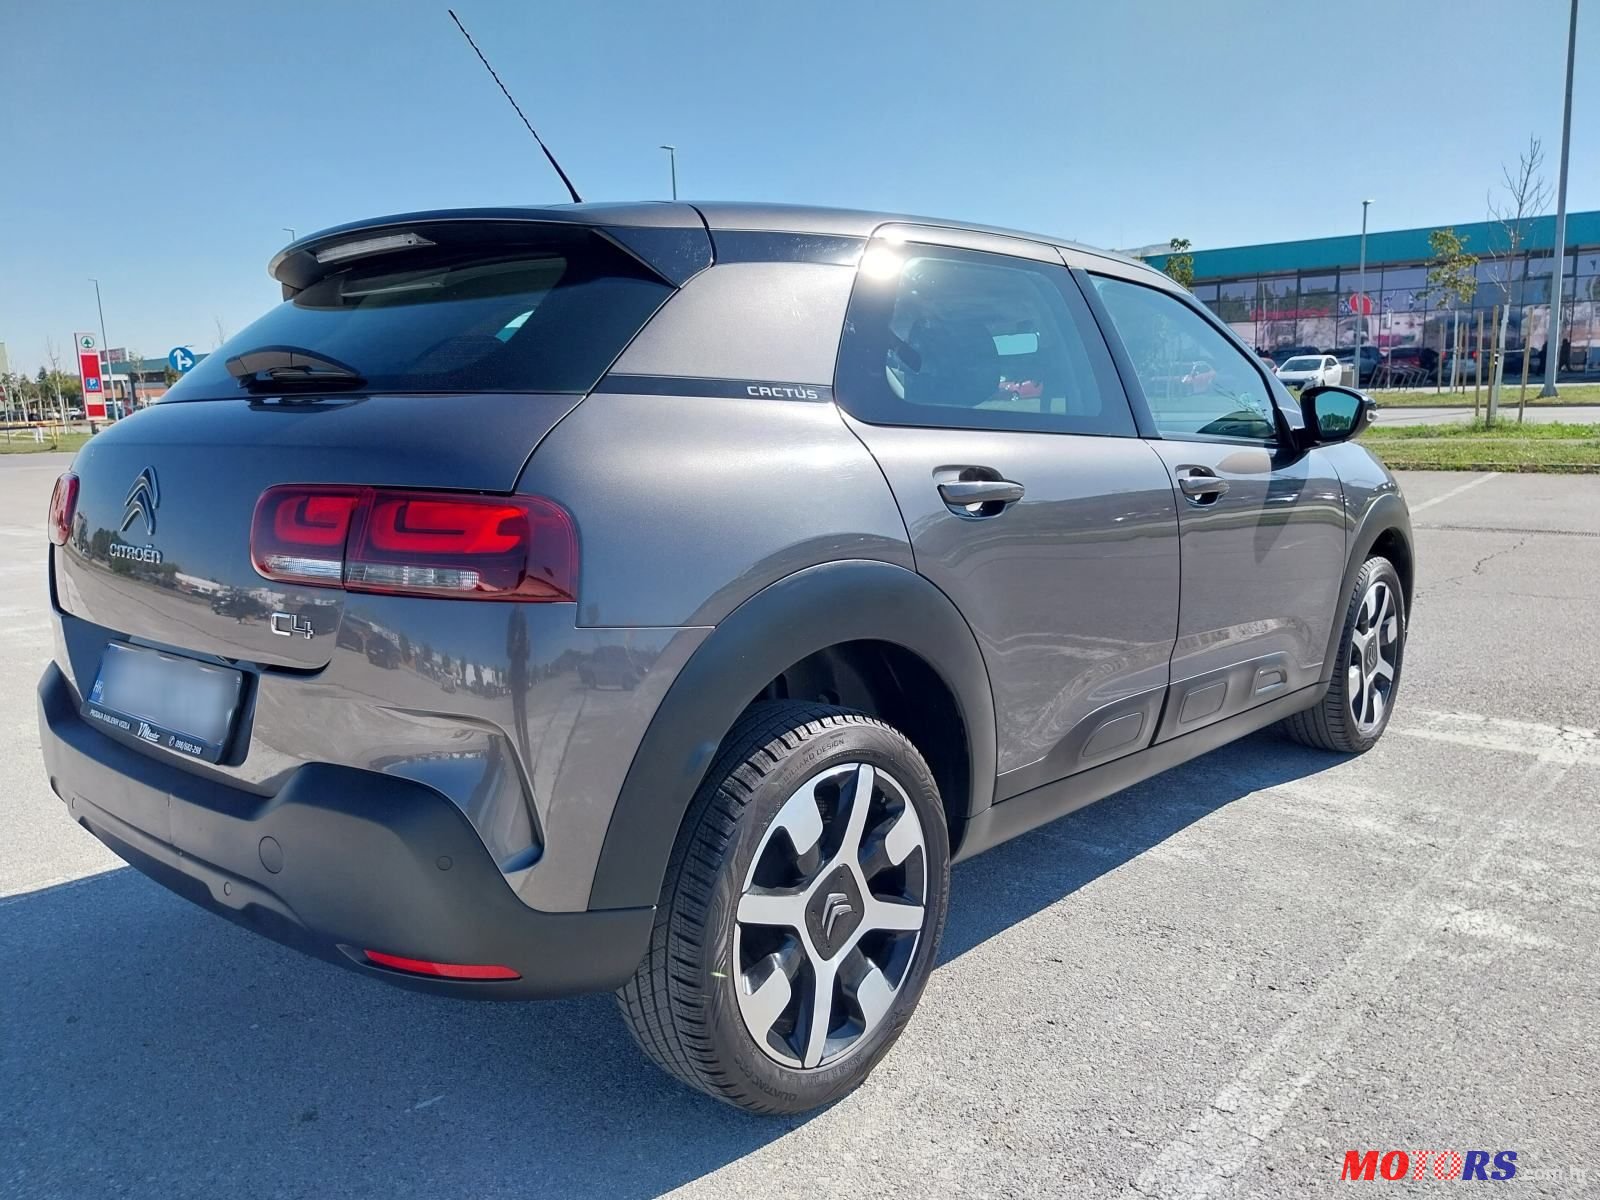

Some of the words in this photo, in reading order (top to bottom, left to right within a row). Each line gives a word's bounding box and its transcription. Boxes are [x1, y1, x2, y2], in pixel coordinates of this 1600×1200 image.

[746, 386, 818, 399] CACTUS
[109, 544, 163, 564] CITROËN
[271, 612, 314, 640] C4
